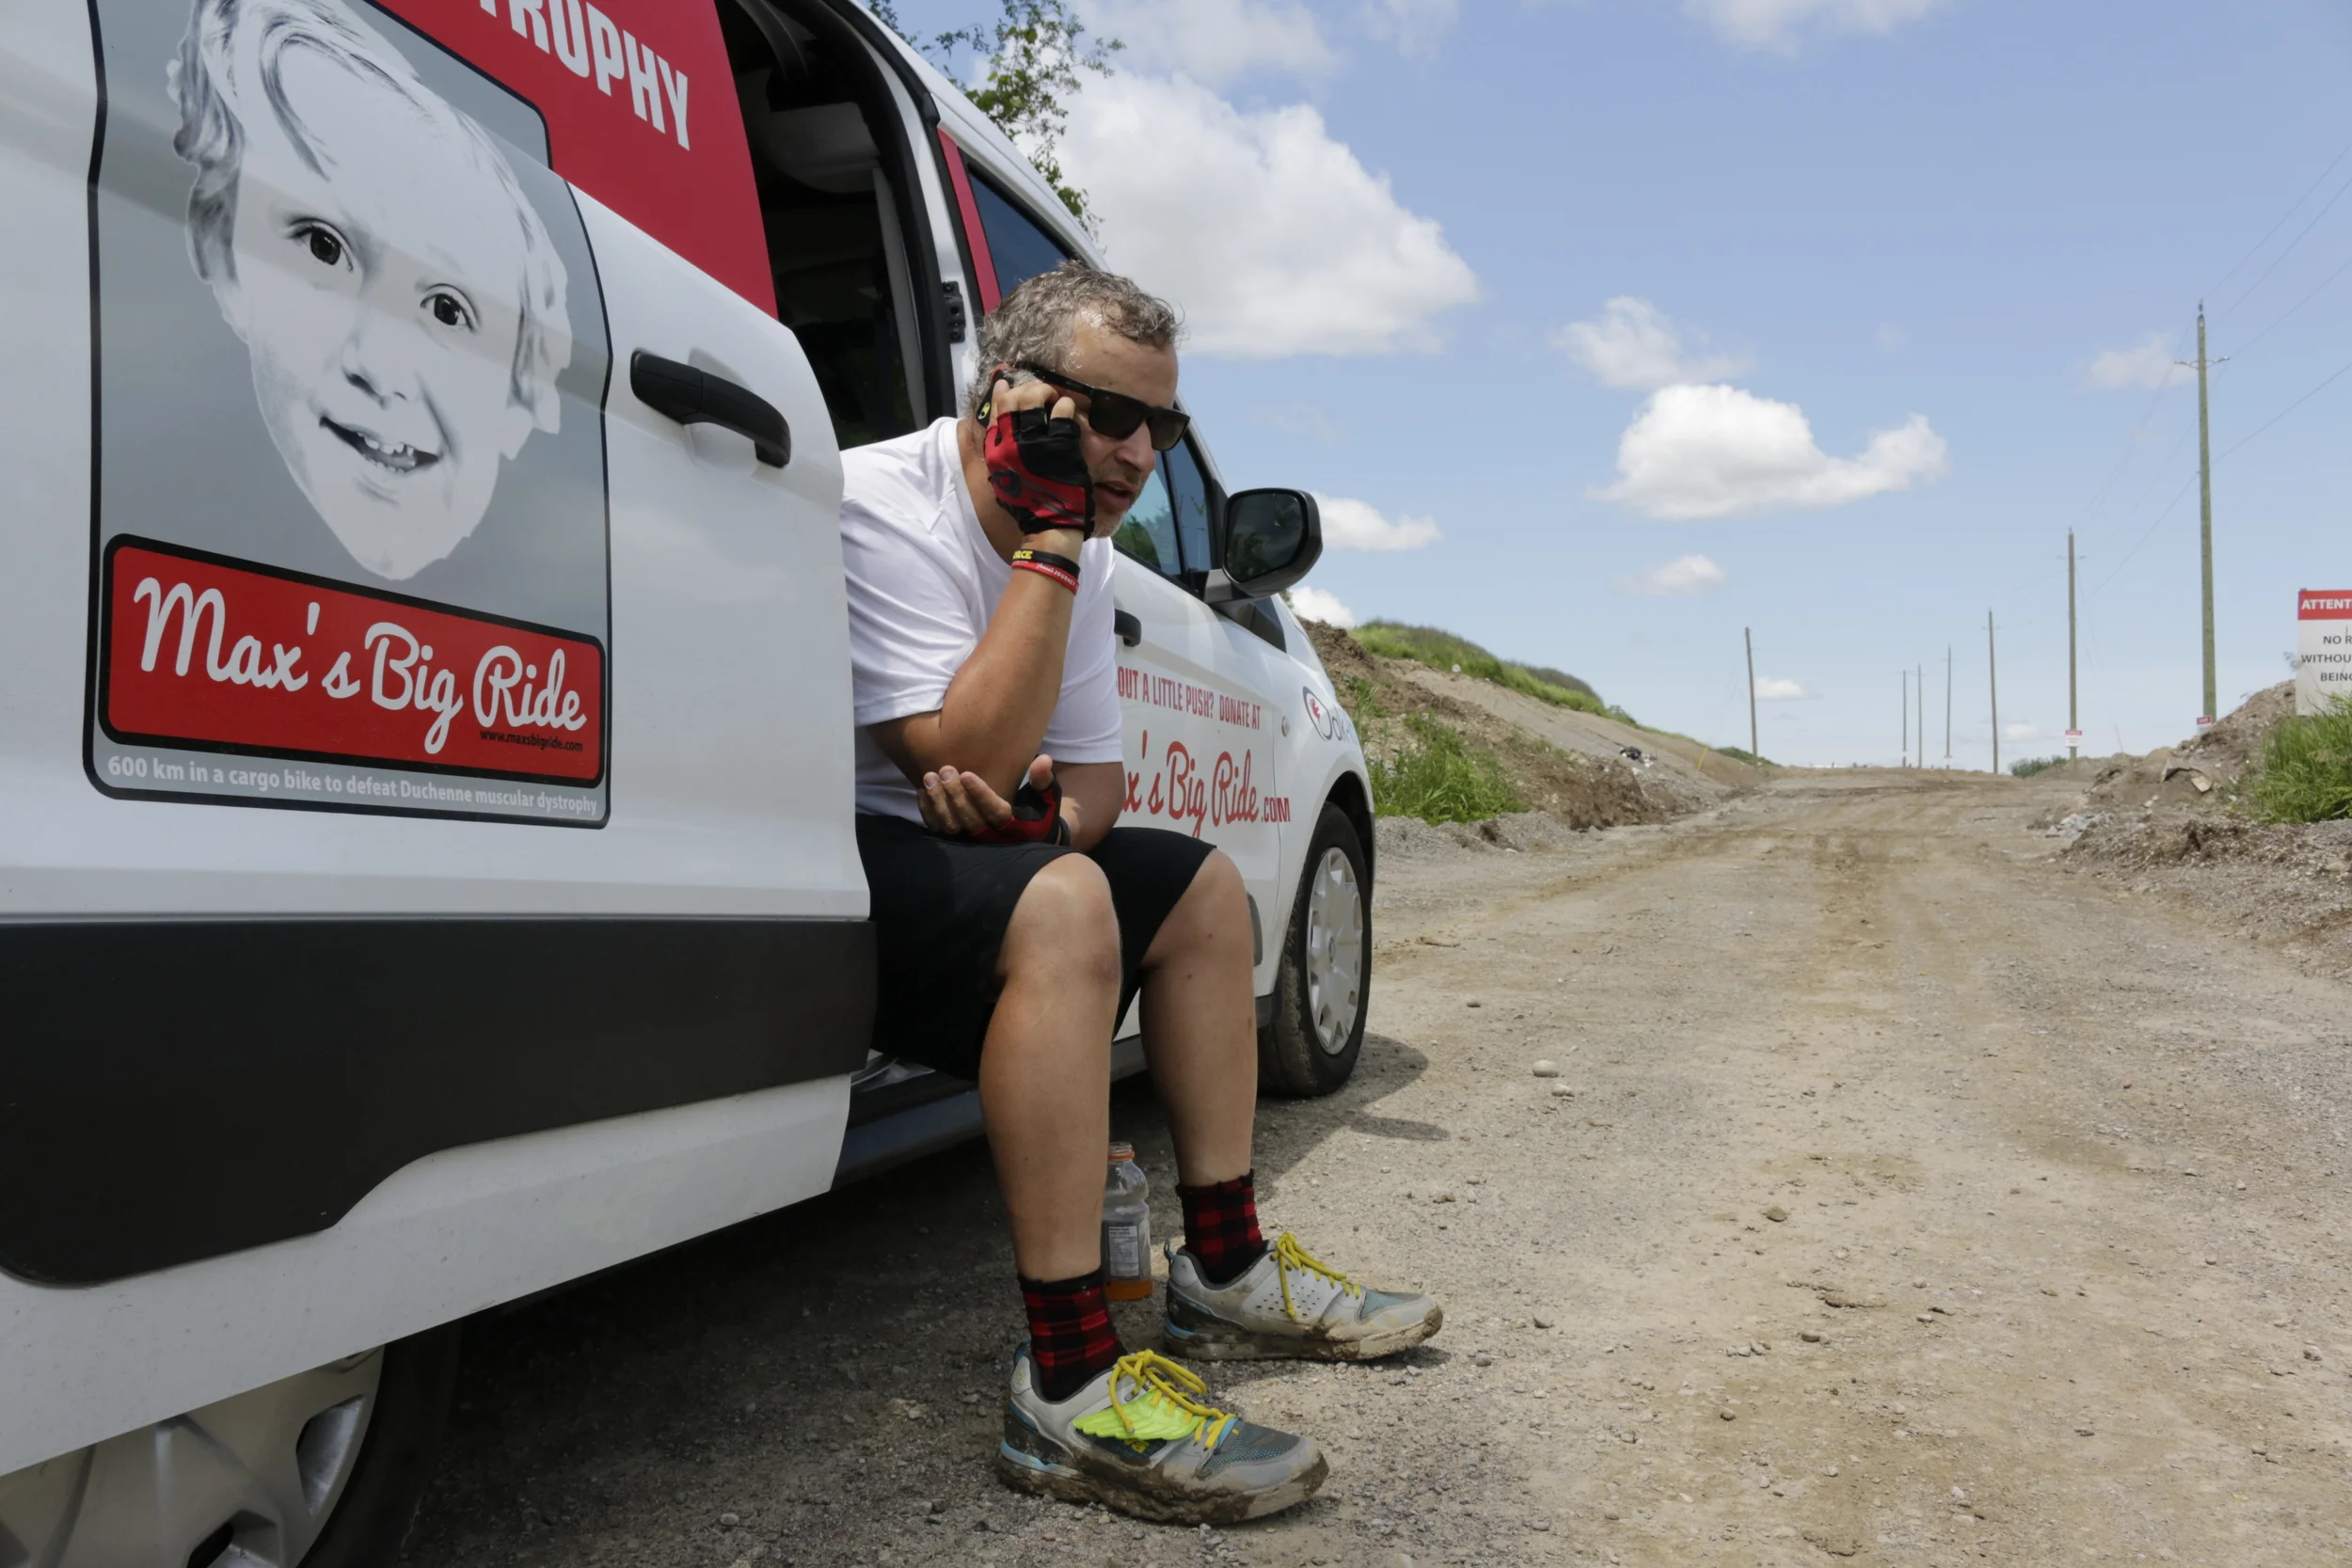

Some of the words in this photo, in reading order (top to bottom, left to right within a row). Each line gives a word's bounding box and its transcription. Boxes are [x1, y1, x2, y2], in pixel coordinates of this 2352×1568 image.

[480, 0, 690, 150] OPHY
[1012, 550, 1033, 560] RCE
[134, 577, 360, 699] Max's
[364, 622, 464, 754] Big
[473, 645, 587, 732] Ride
[2323, 635, 2342, 644] NO
[1117, 665, 1138, 701] OUT
[1142, 673, 1150, 704] A
[1152, 675, 1183, 711] LITTLE
[1185, 685, 1215, 719] PUSH?
[1219, 694, 1250, 728] DONATE
[1251, 705, 1261, 730] AT
[480, 729, 583, 752] www.maxsbigride.com
[108, 756, 147, 777] 600
[153, 758, 184, 781] km
[190, 761, 208, 783] in
[213, 768, 224, 784] a
[229, 769, 279, 792] cargo
[284, 768, 321, 791] bike
[325, 775, 342, 792] to
[346, 775, 397, 798] defeat
[401, 780, 472, 802] Duchenne
[475, 789, 534, 807] muscular
[537, 792, 597, 816] dystrophy
[1167, 741, 1207, 839] Big
